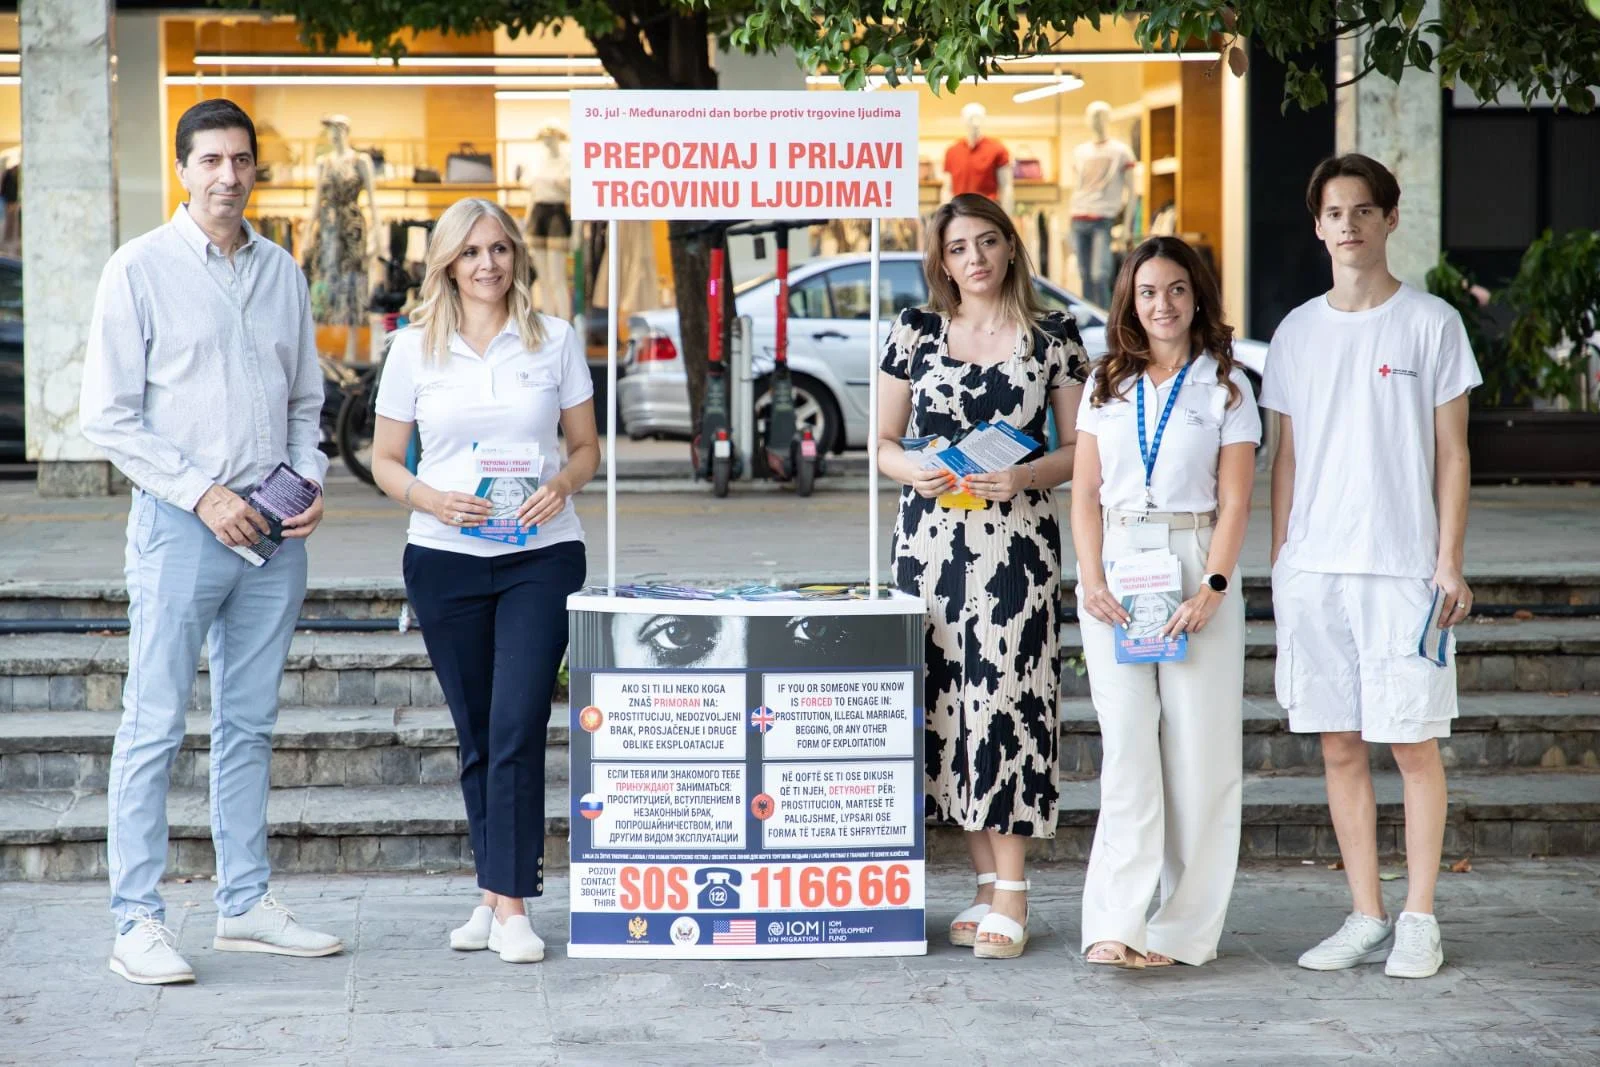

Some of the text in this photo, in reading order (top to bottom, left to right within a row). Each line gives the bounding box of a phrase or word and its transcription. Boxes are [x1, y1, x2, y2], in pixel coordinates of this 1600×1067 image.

[585, 107, 602, 118] 30.
[605, 107, 620, 120] jul
[629, 107, 706, 118] Međunarodni
[709, 107, 730, 118] dan
[733, 107, 768, 118] borbe
[770, 107, 804, 120] protiv
[807, 107, 855, 120] trgovine
[857, 107, 901, 120] ljudima
[584, 142, 757, 169] PREPOZNAJ
[789, 142, 903, 169] PRIJAVI
[592, 181, 892, 208] TRGOVINU LJUDIMA!
[621, 684, 725, 694] AKO SI TI ILI NEKO KOGA
[778, 682, 904, 693] IF YOU OR SOMEONE YOU KNOW
[629, 696, 718, 707] ZNAŠ PRIMORAN NA:
[791, 696, 892, 707] IS FORCED TO ENGAGE IN:
[608, 712, 741, 723] PROSTITUCIJU, NEDOZVOLJENI
[775, 710, 907, 722] PROSTITUTION, ILLEGAL MARRIAGE,
[610, 726, 636, 736] BRAK,
[638, 724, 700, 735] PROSJAČENJE
[708, 726, 737, 735] DRUGE
[795, 724, 887, 736] BEGGING, OR ANY OTHER
[623, 740, 724, 749] OBLIKE EKSPLOATACIJE
[797, 738, 886, 748] FORM OF EXPLOITATION
[608, 770, 740, 779] ЕСЛИ ТЕБЯ ИЛИ ЗНАКОМОГО ТЕБЕ
[782, 770, 894, 782] NË QOFTË SE TI OSE DIKUSH
[616, 782, 732, 793] ПРИНУЖДАЮТ ЗАНИМАТЬСЯ:
[780, 783, 896, 797] QË TI NJEH, DETYROHET PËR:
[607, 793, 673, 806] ПРОСТИТУЦИЕЙ,
[675, 795, 734, 804] ВСТУПЛЕНИЕМ
[781, 797, 894, 811] PROSTITUCION, MARTESË TË
[634, 806, 713, 818] НЕЗАКОННЫЙ БРАК,
[615, 818, 732, 831] ПОПРОШАЙНИЧЕСТВОМ, ИЛИ
[785, 812, 891, 825] PALIGJSHME, LYPSARI OSE
[768, 823, 907, 837] FORMA TË TJERA TË SHFRYTËZIMIT
[609, 833, 738, 844] ДРУГИМ ВИДОМ ЭКСПЛУАТАЦИИ
[589, 867, 616, 875] POZOVI
[581, 878, 616, 886] CONTACT
[751, 867, 791, 908] 11
[620, 866, 689, 911] SOS
[710, 892, 726, 901] 122
[594, 899, 616, 907] THIRR
[787, 921, 819, 935] IOM
